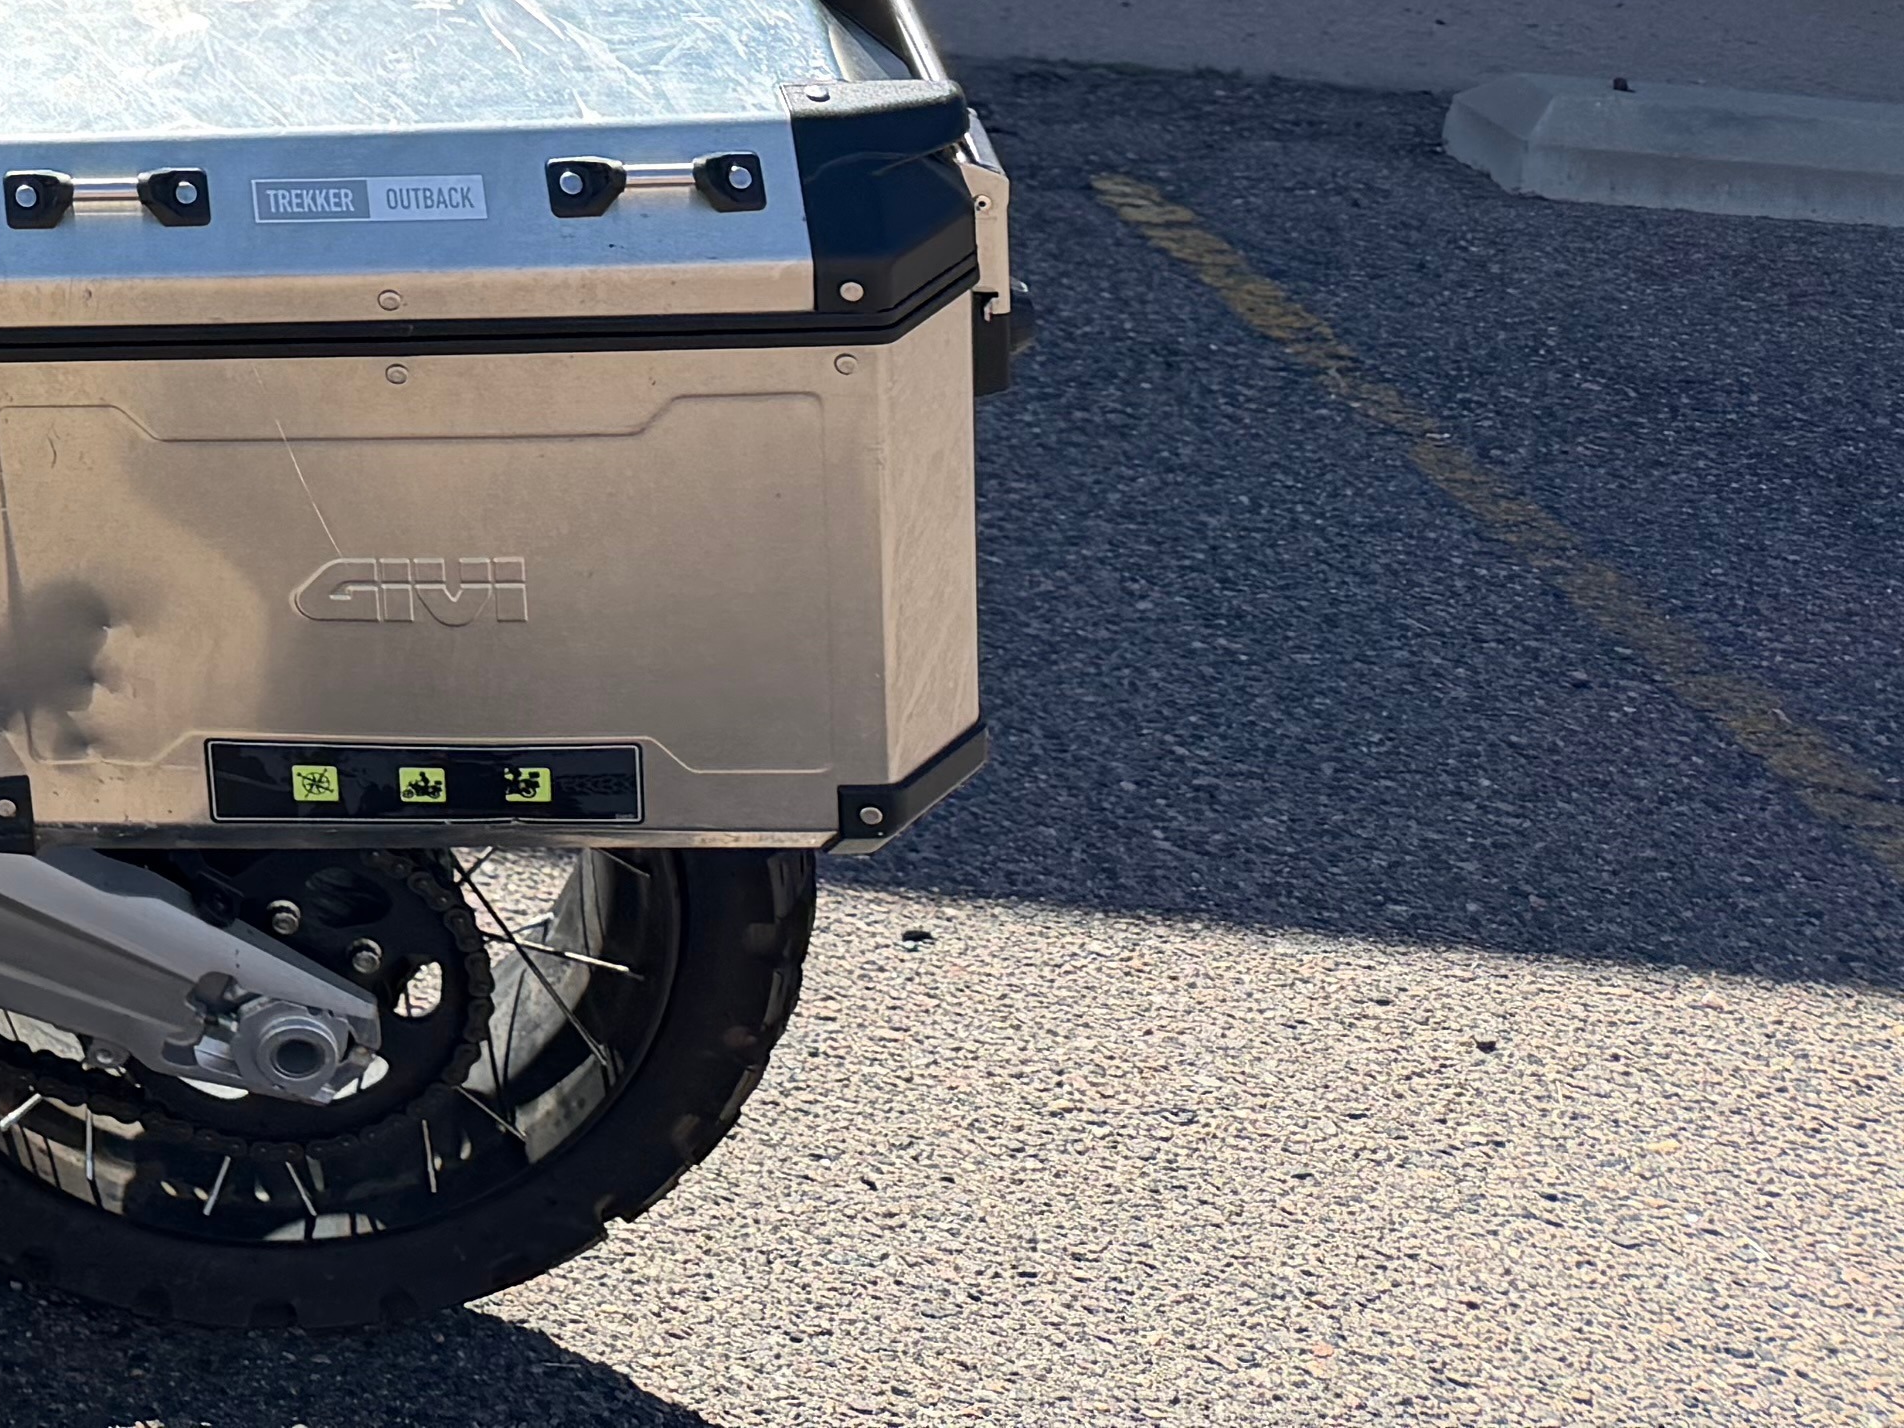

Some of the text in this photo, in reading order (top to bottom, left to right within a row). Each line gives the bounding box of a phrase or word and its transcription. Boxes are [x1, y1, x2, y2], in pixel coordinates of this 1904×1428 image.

[266, 186, 475, 213] TREKKER OUTBACK
[290, 556, 528, 628] GIVI
